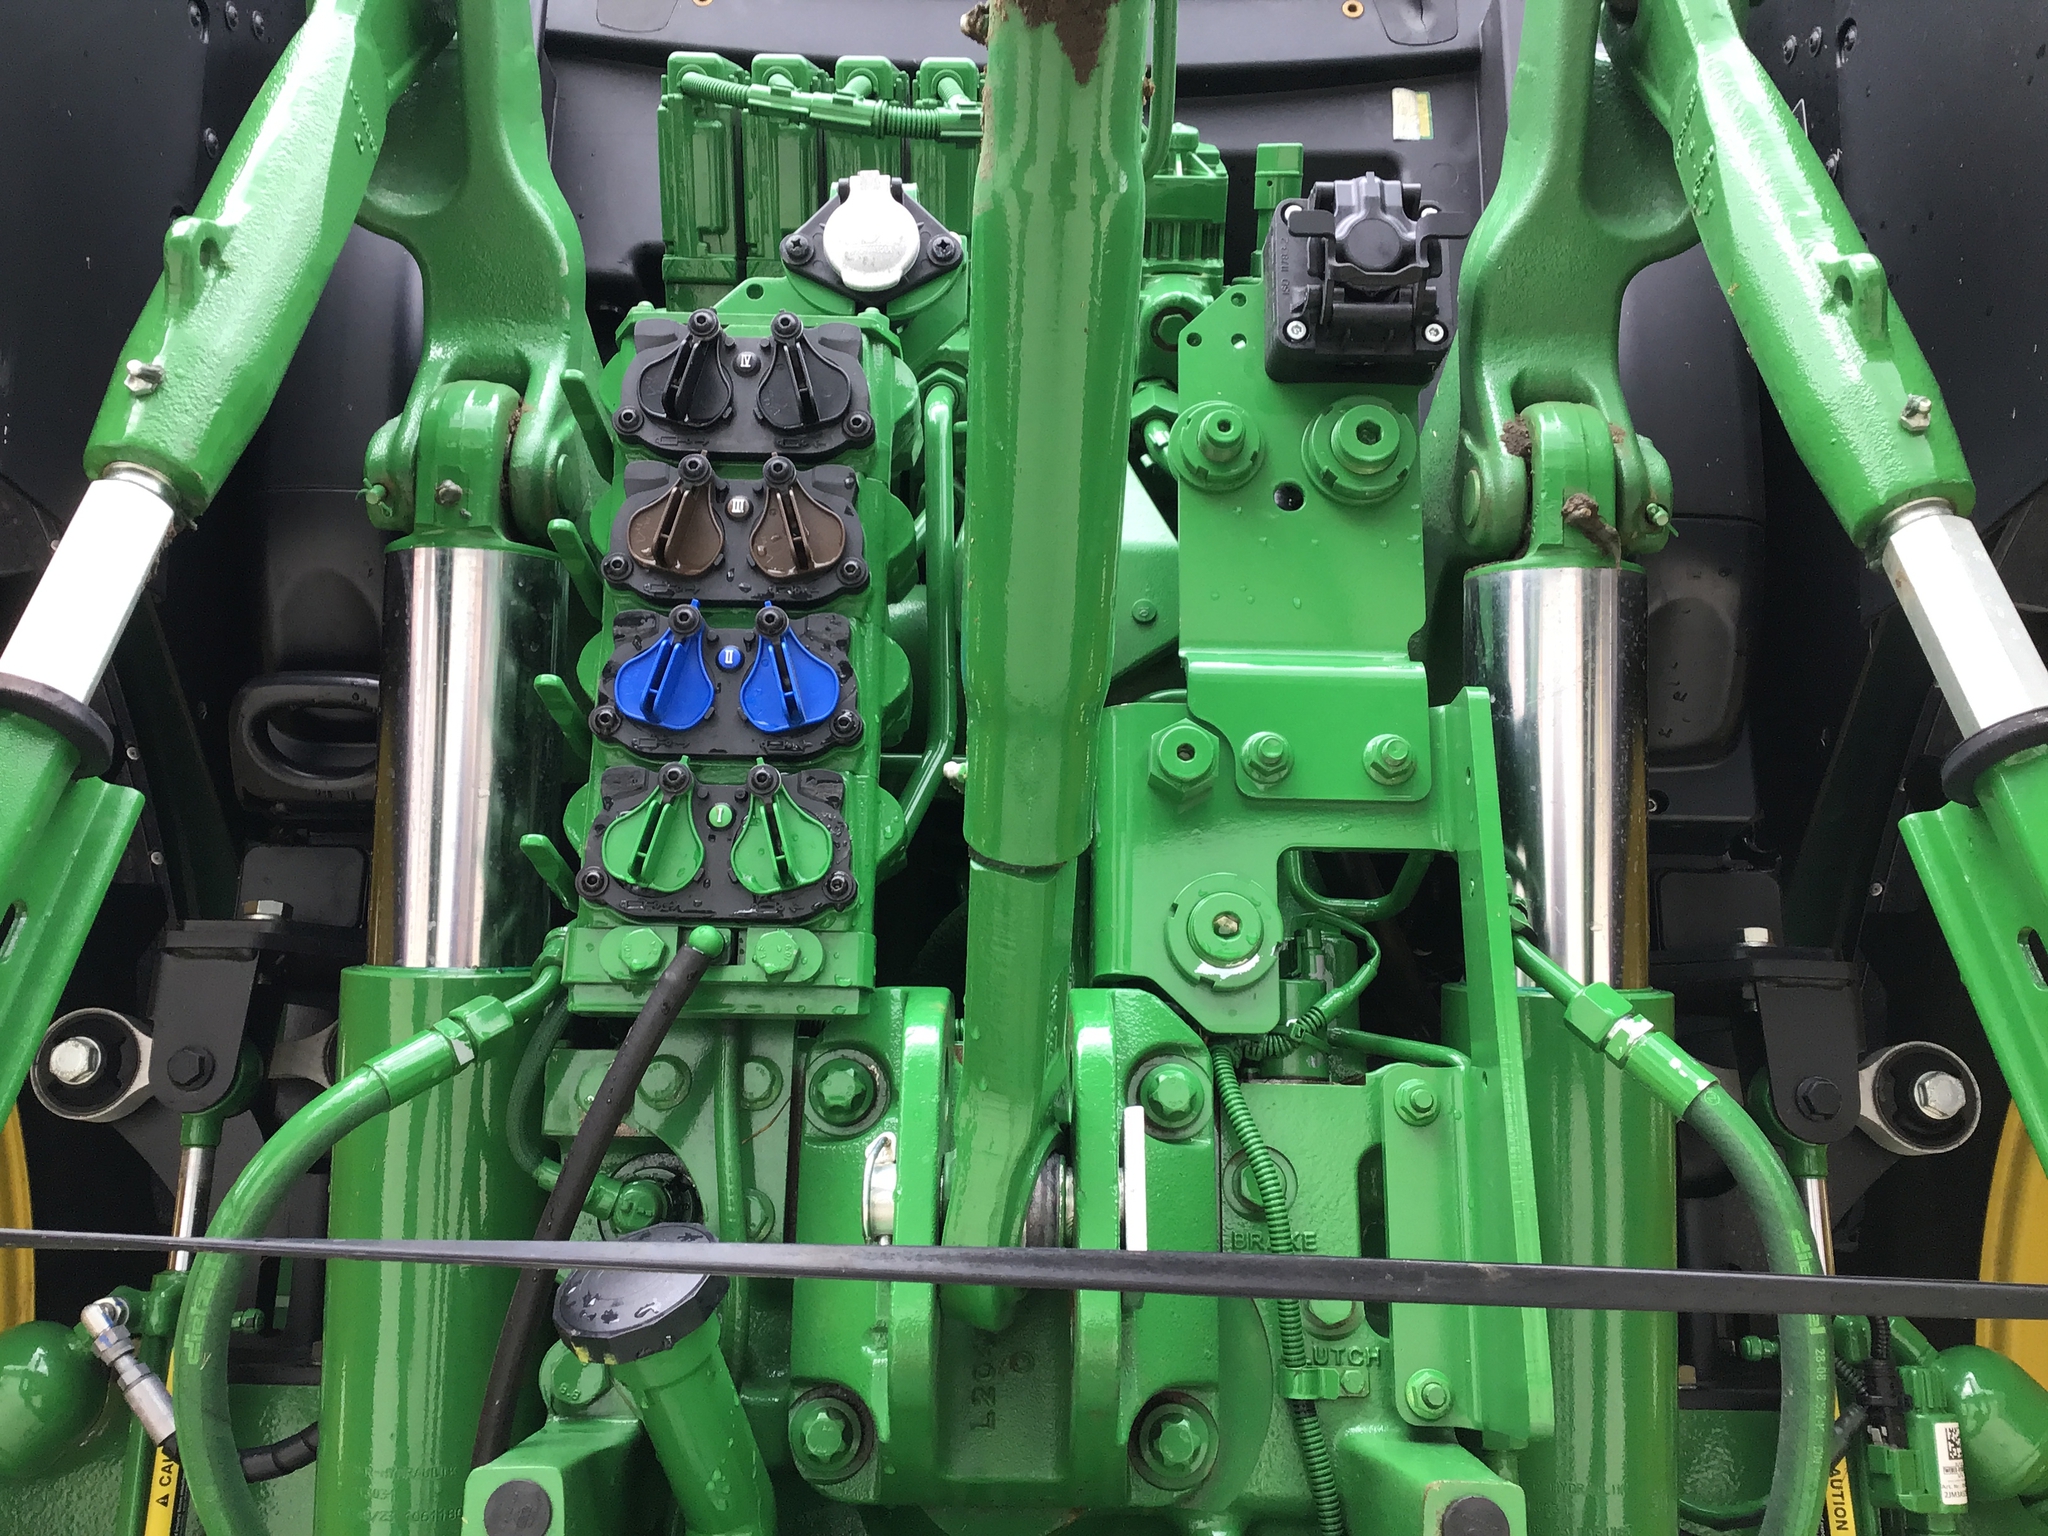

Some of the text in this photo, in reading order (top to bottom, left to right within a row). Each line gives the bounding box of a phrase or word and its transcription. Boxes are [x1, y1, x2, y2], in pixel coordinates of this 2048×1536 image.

[740, 353, 751, 367] IV
[731, 500, 744, 513] III
[725, 649, 733, 663] II
[1232, 1231, 1318, 1251] BRKE
[1829, 1469, 1849, 1531] AUTION
